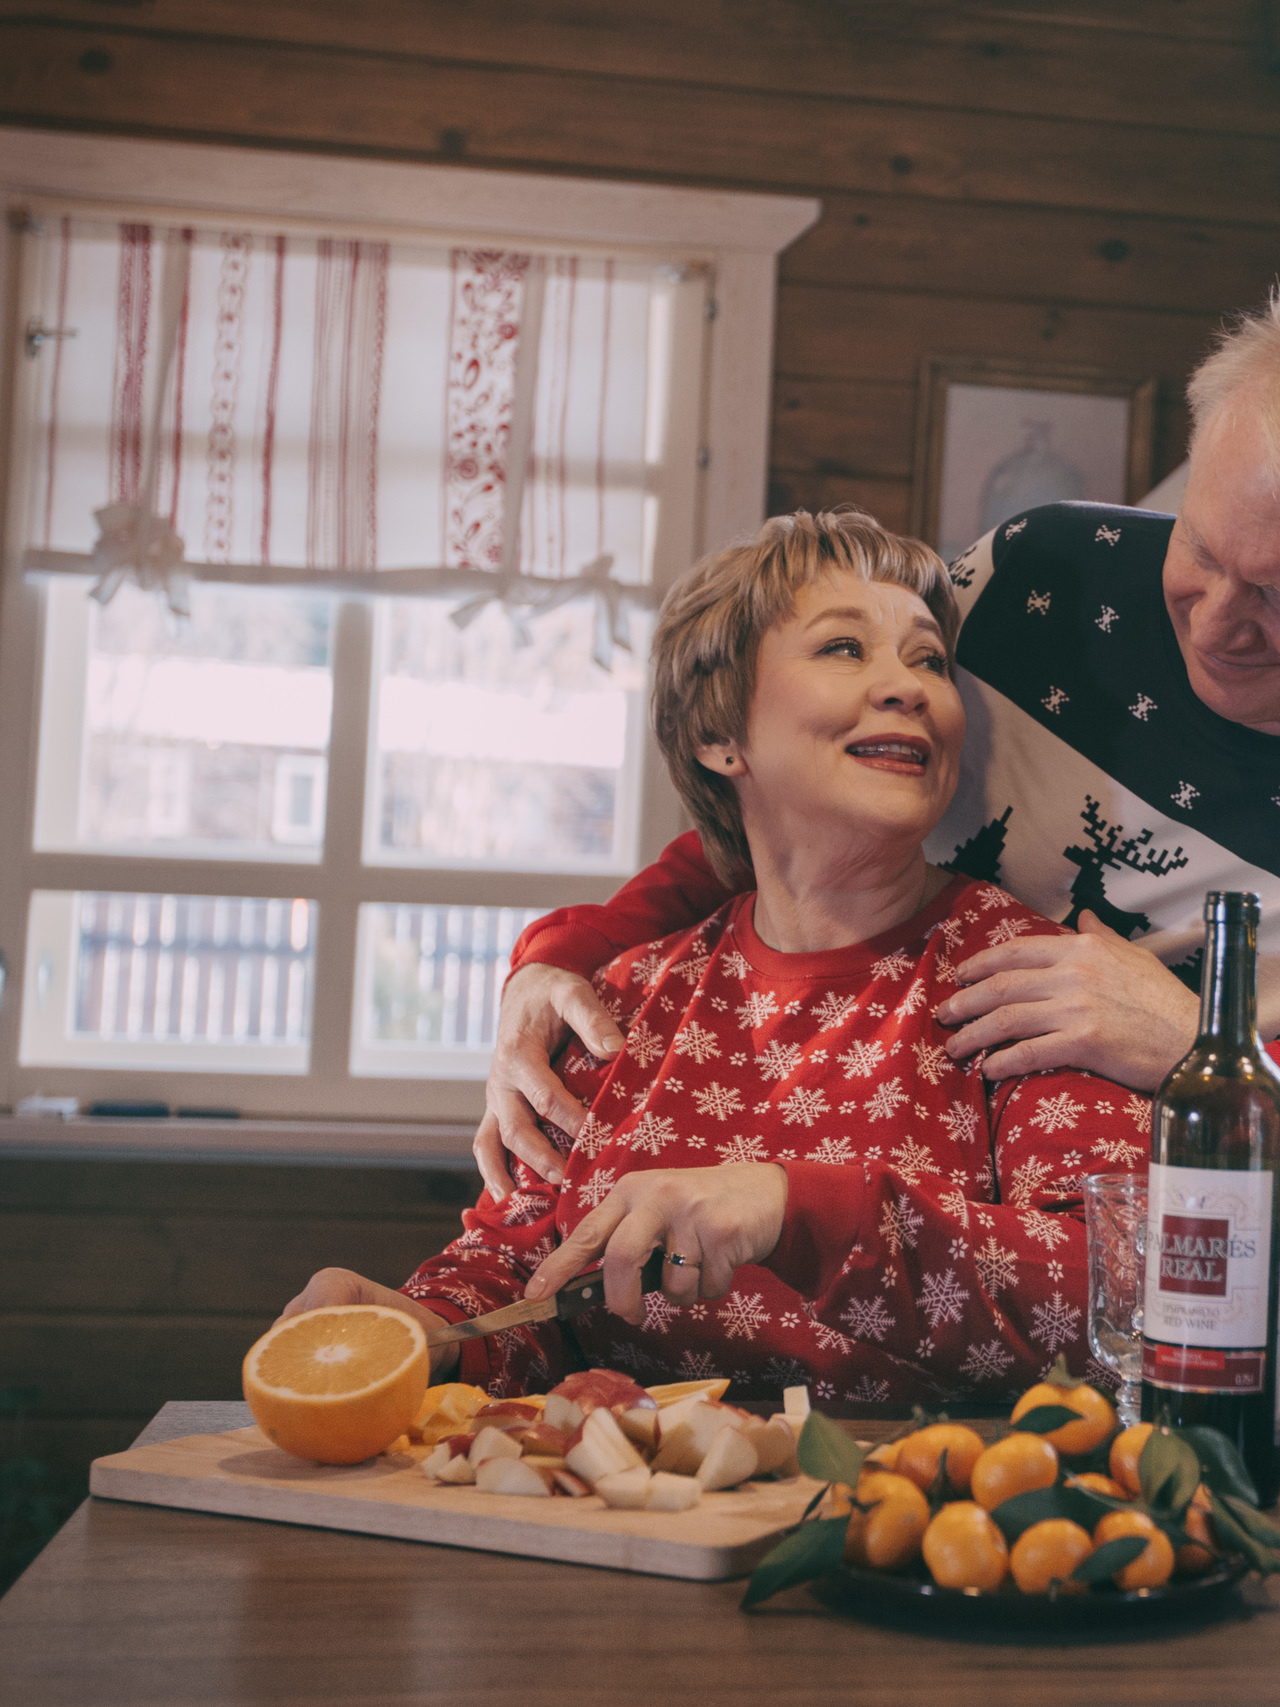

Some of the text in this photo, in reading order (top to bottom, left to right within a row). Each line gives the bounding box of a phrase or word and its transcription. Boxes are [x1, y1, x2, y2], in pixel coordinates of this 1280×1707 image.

[1160, 1258, 1223, 1282] REAL
[1163, 1316, 1217, 1331] RED WINE
